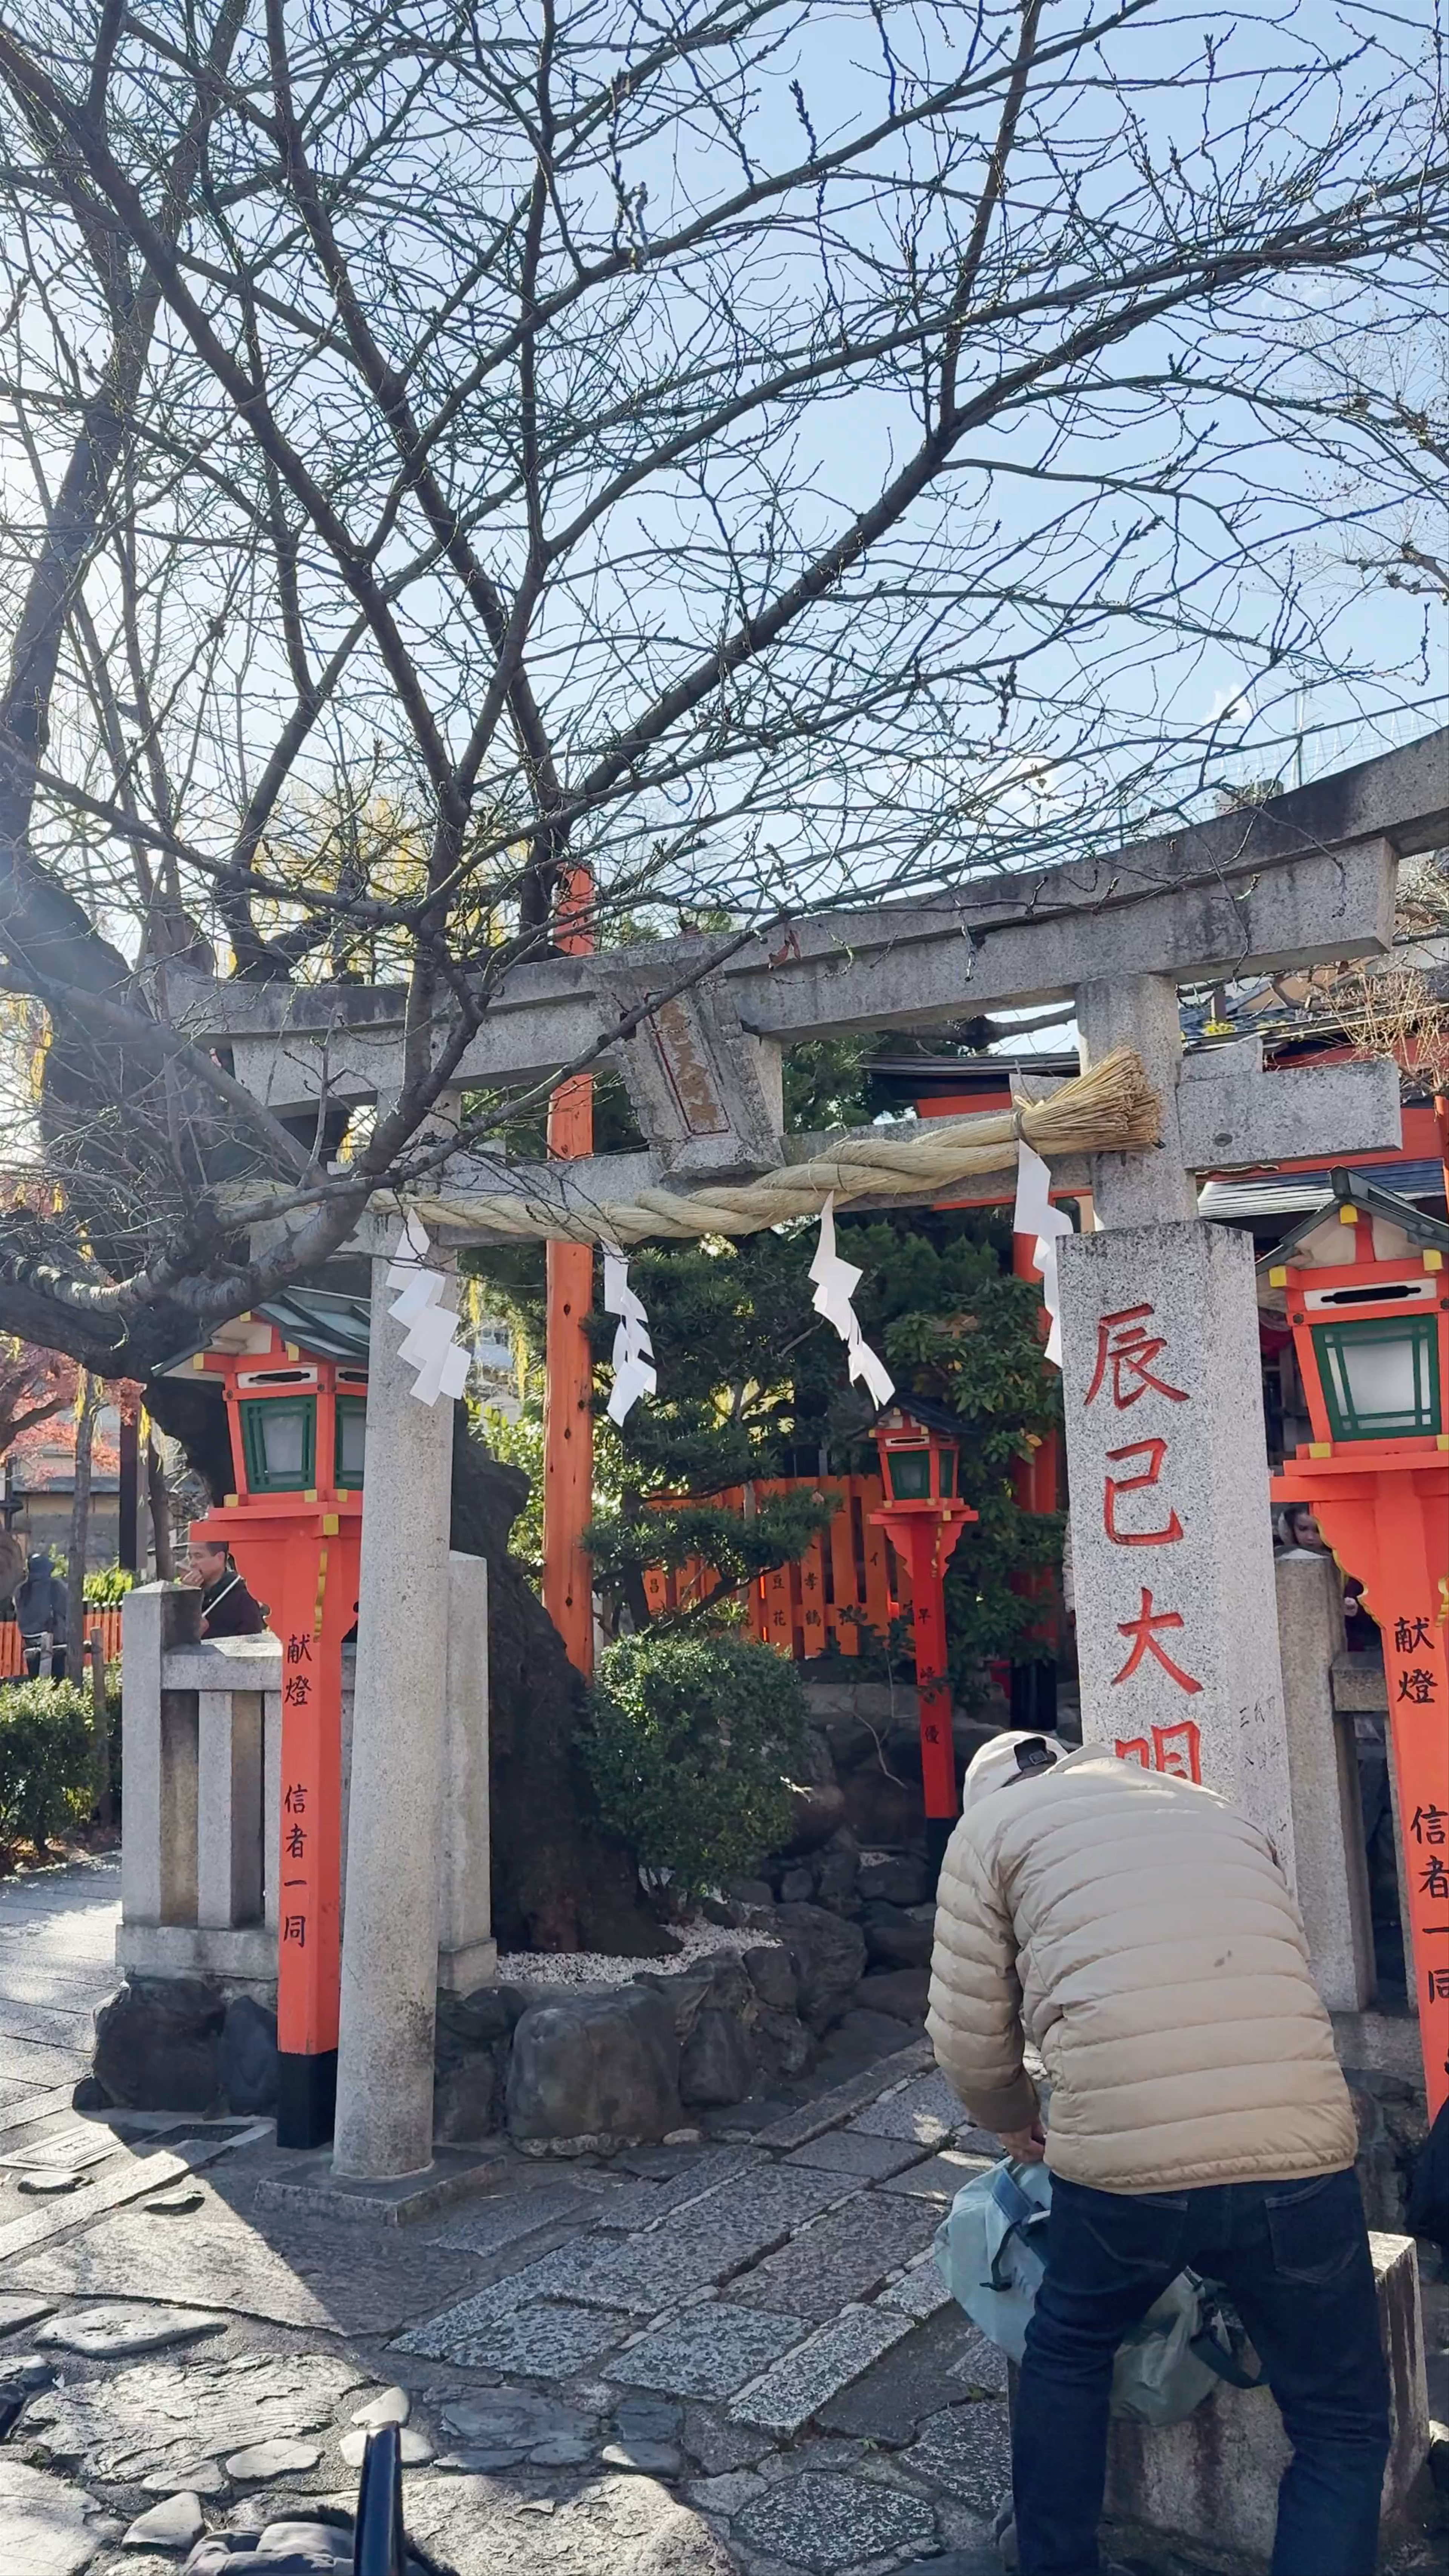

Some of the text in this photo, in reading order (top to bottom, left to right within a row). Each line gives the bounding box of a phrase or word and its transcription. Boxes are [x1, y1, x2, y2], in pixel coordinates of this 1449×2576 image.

[1394, 1616, 1438, 1704] 献燈
[283, 1633, 313, 1948] 献燈 信者一同
